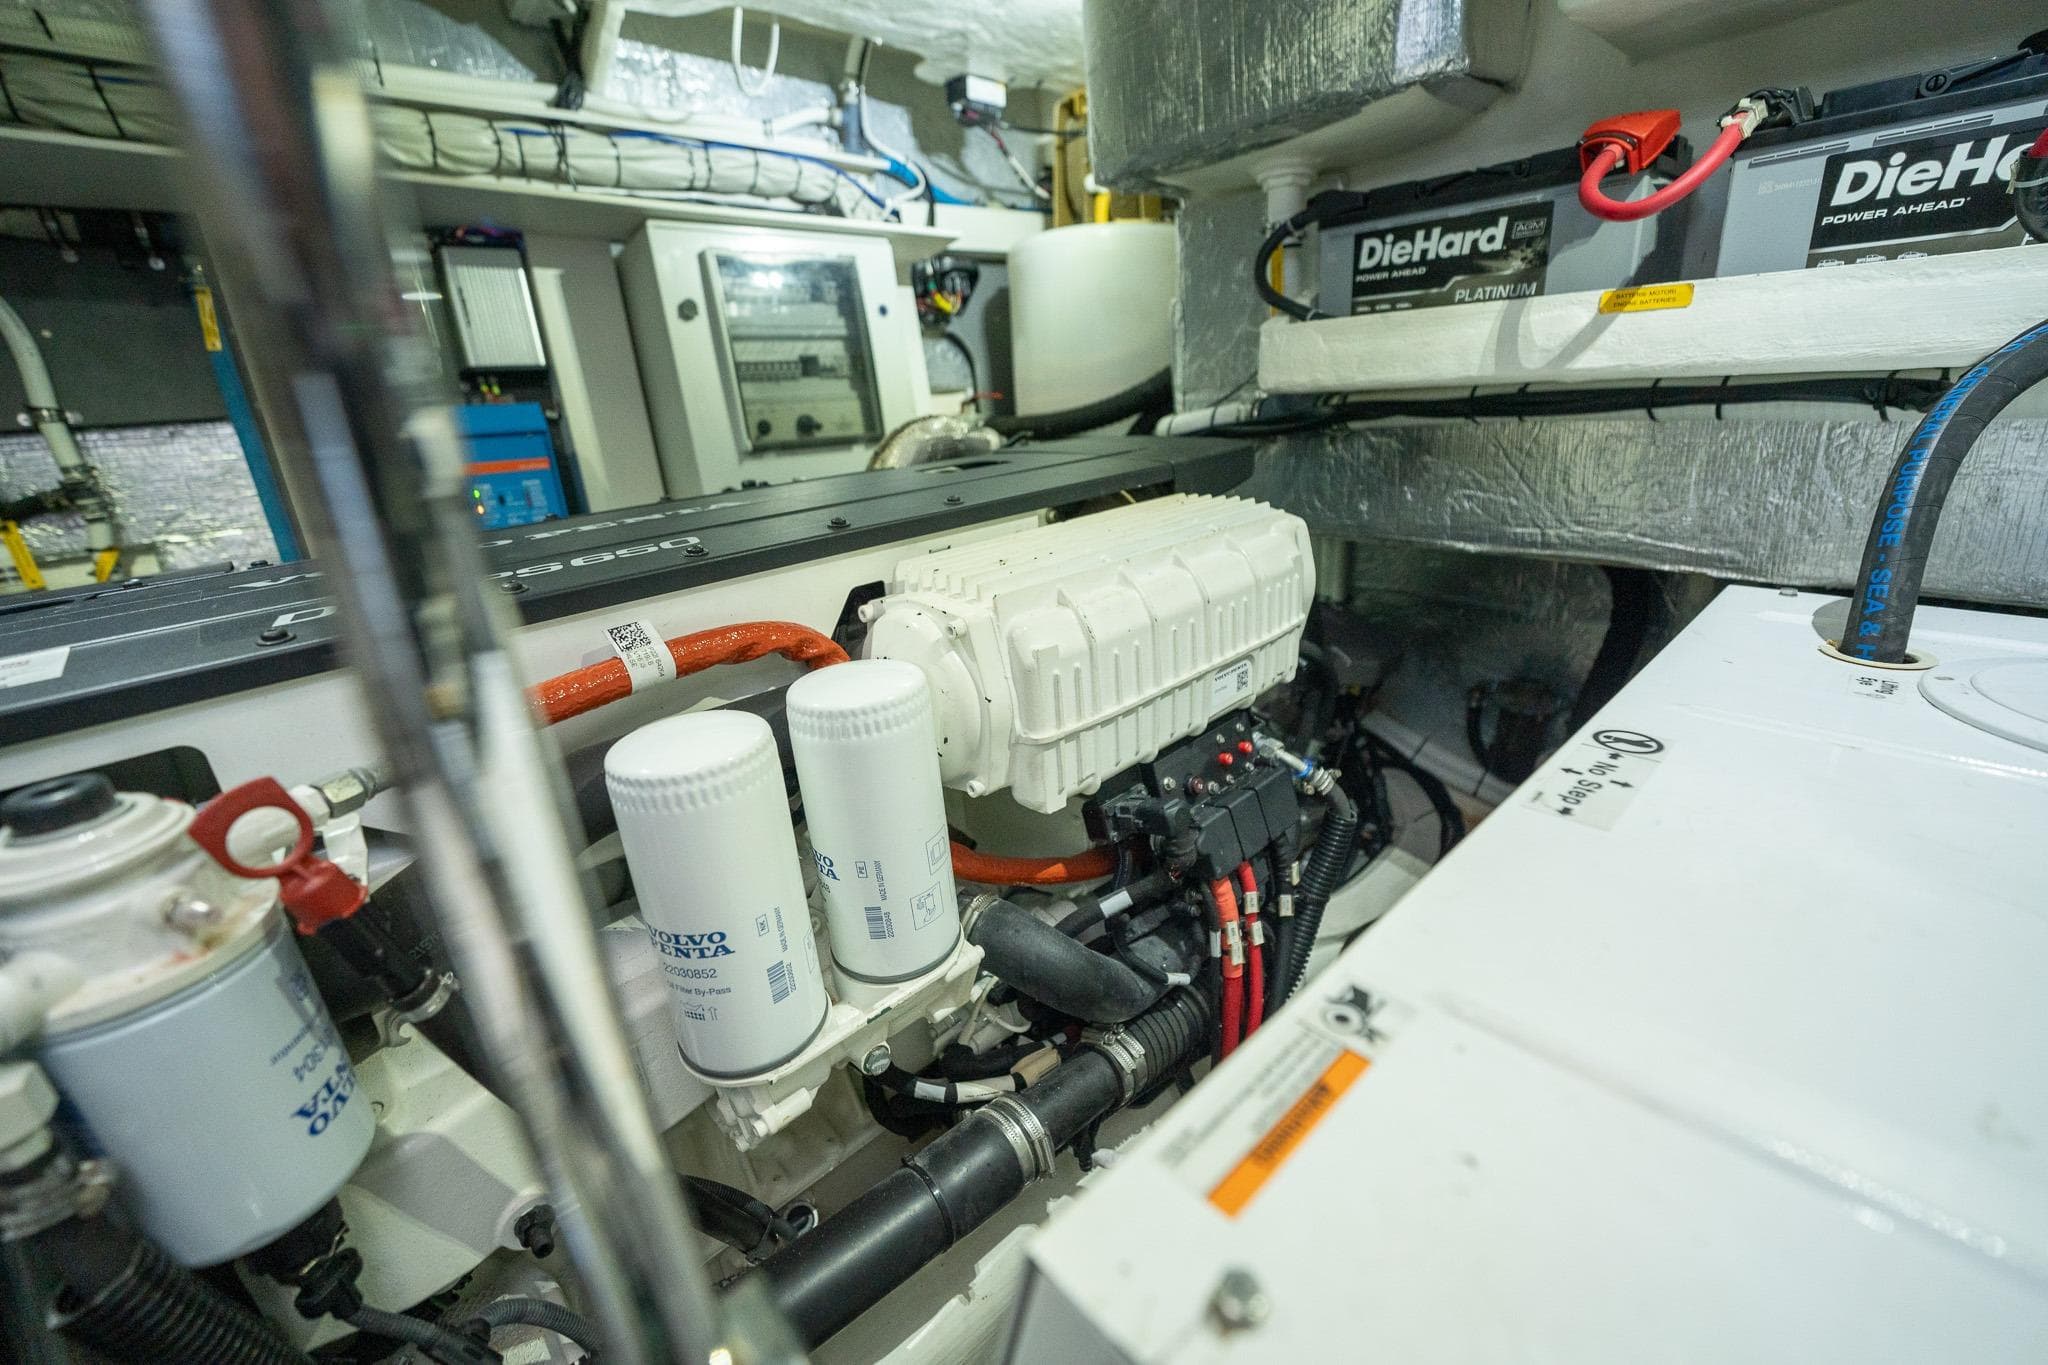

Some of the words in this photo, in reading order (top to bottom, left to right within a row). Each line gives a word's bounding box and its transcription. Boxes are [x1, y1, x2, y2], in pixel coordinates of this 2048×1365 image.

[1830, 134, 2034, 206] DieH
[1821, 209, 1888, 226] POWER
[1893, 198, 1966, 217] AHEAD
[1358, 216, 1509, 271] DieHard
[1355, 272, 1390, 283] POWER
[1391, 266, 1427, 279] AHEAD
[1455, 282, 1538, 304] PLATINUM
[1640, 297, 1677, 305] BATTERIES
[1914, 365, 1989, 446] GENERAL
[1878, 447, 1931, 549] PURPOSE
[570, 536, 701, 567] 650
[1863, 567, 1893, 616] SEA
[1859, 621, 1881, 637] &
[1588, 761, 1619, 776] No
[1558, 779, 1603, 806] Step
[647, 924, 727, 946] VOLVO
[694, 987, 732, 997] By-Pass
